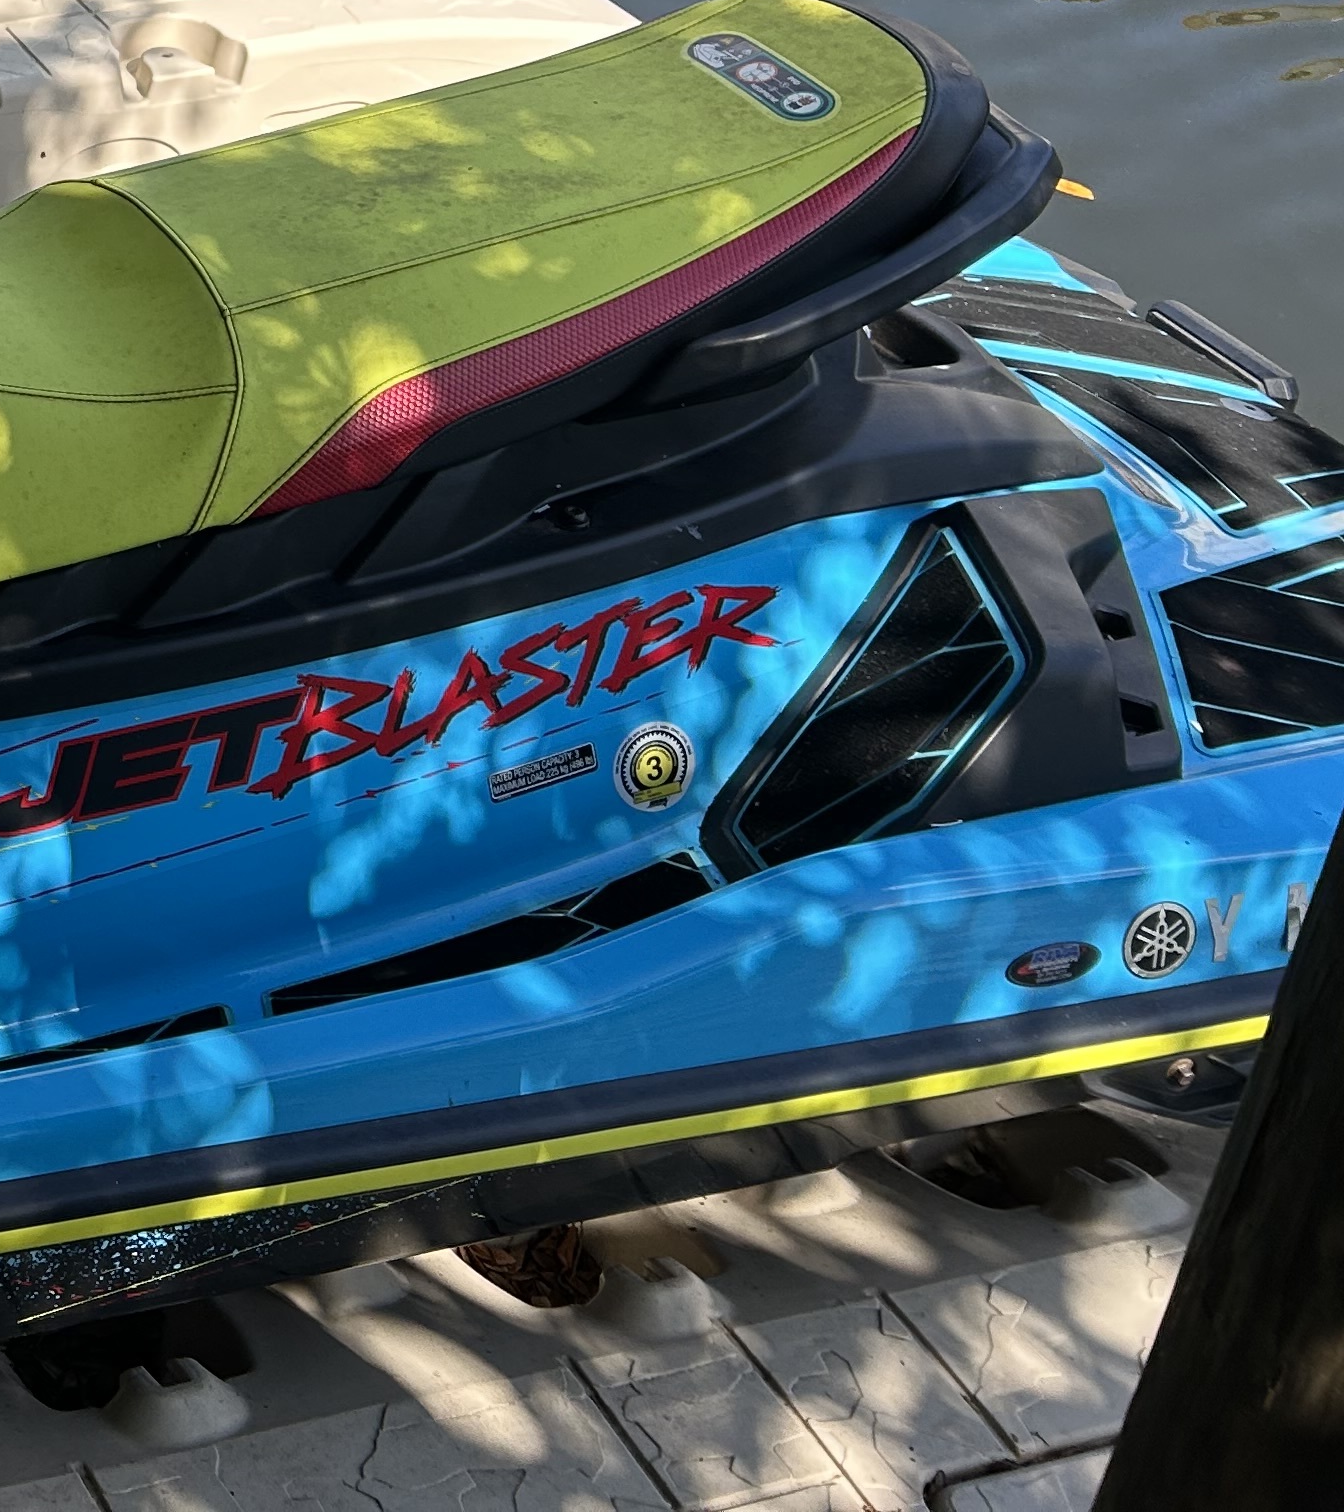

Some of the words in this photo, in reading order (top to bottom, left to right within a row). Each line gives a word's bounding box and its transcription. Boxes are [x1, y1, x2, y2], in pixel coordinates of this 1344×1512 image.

[527, 770, 545, 785] LOAD
[545, 766, 560, 779] 225
[646, 755, 663, 781] 3
